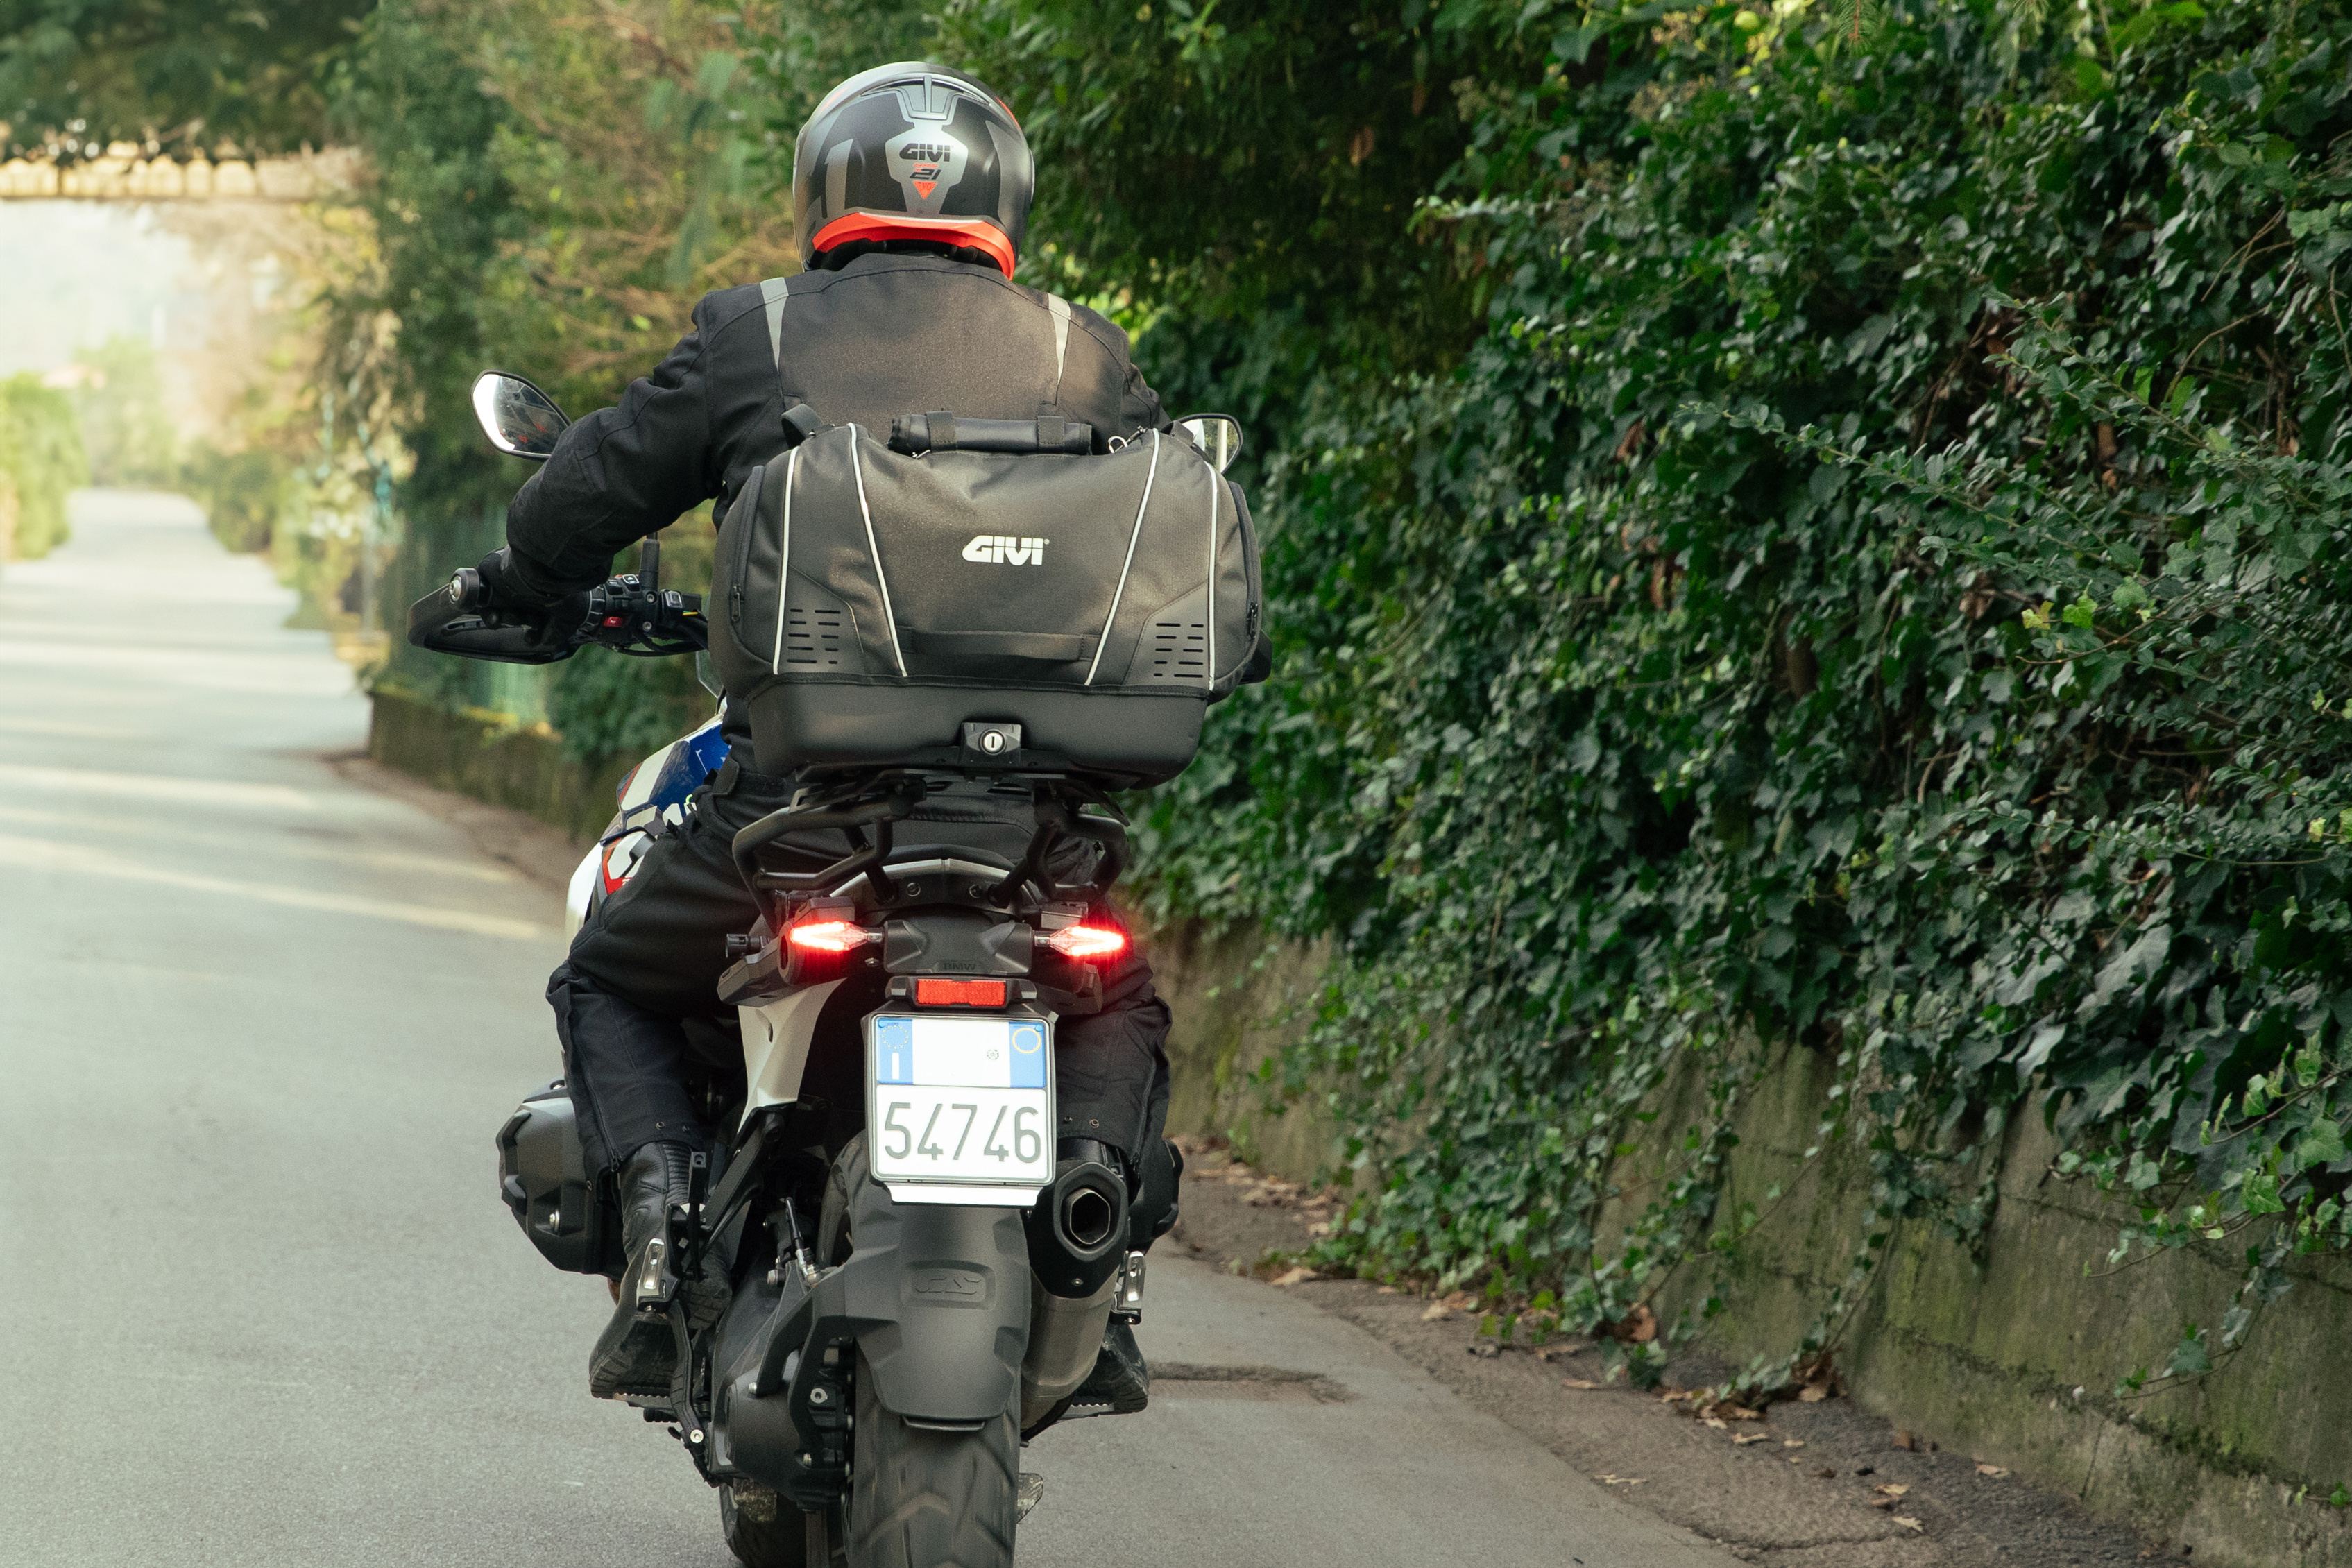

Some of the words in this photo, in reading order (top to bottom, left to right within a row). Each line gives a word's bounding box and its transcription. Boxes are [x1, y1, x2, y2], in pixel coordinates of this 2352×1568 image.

[899, 143, 951, 162] GIVI
[962, 535, 1043, 566] GIVI
[944, 962, 976, 971] BMW
[892, 1052, 900, 1080] I
[885, 1102, 1041, 1164] 54746
